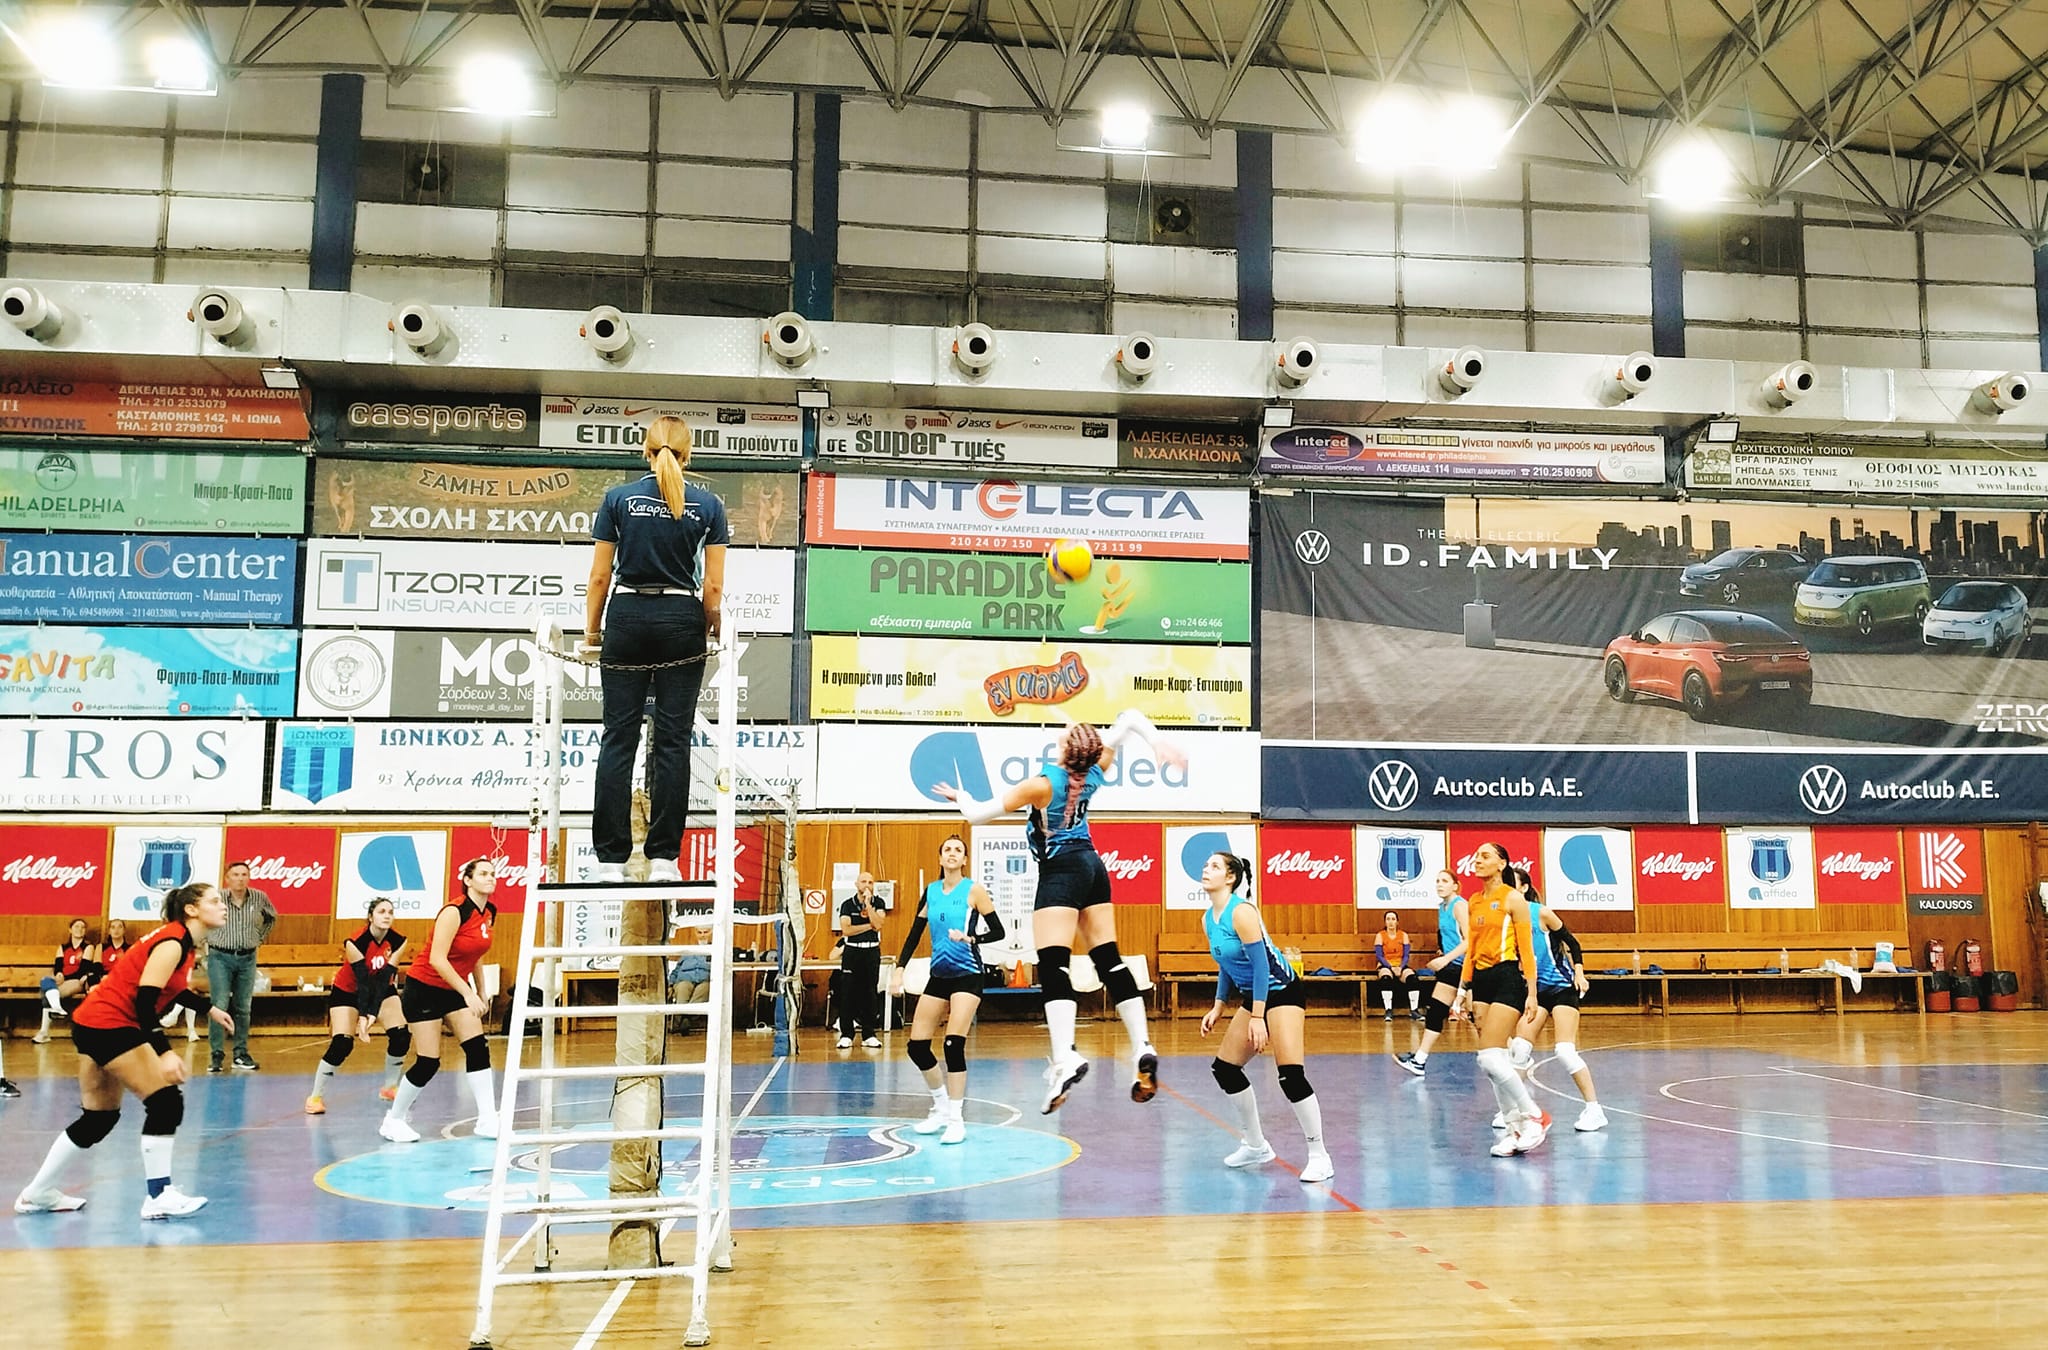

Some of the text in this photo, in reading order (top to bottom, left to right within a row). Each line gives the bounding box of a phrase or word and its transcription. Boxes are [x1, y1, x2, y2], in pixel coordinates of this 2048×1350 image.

[0, 381, 74, 396] ΩΛΕΙΟ
[118, 385, 187, 396] ΔΕΚΕΛΕΙΑΣ
[153, 398, 174, 408] 210
[177, 399, 227, 409] 2533079
[546, 404, 573, 414] PUMA
[594, 405, 619, 415] asics
[116, 410, 201, 421] ΚΑΣΤΑΜΟΝΗΣ
[204, 413, 228, 424] 142,
[248, 414, 281, 424] ΙΩΝΙΑ
[349, 402, 527, 436] cassports
[922, 418, 947, 427] PUMA
[969, 418, 991, 428] asics
[151, 422, 172, 432] 210
[175, 423, 224, 433] 2799701
[856, 430, 947, 456] super
[1228, 434, 1249, 448] 53,
[1295, 436, 1349, 447] intered
[1593, 443, 1607, 451] και
[1735, 445, 1854, 455] ΑΡΧΙΤΕΚΤΟΝΙΚΗ ΤΟΠΙΟΥ
[1764, 457, 1814, 465] ΠΡΑΣΙΝΟΥ
[1386, 464, 1431, 473] ΔΕΚΕΛΕΙΑΣ
[1434, 465, 1449, 474] 114
[1735, 467, 1838, 477] ΓΗΠΕΔΑ ΤΕΝΝΙΣ
[418, 468, 571, 497] ΣΑΜΗΣ LAND
[1735, 478, 1811, 487] ΑΠΟΛΥΜΑΝΣΕΙΣ
[1874, 479, 1893, 488] 210
[369, 505, 476, 530] ΣΧΟΛΗ
[486, 508, 599, 534] ΣΚΥΛΩ
[884, 520, 934, 530] ΣΥΣΤΗΜΑΤΑ
[936, 522, 992, 532] ΣΥΝΑΓΕΡΜΟΥ
[1001, 525, 1040, 534] ΚΑΜΕΡΕΣ
[1042, 527, 1090, 536] ΑΣΦΑΛΕΙΑΣ
[1418, 528, 1445, 540] THE
[950, 536, 1032, 549] 210 24 07 150
[1112, 543, 1124, 552] 11
[1129, 544, 1143, 553] 99
[1362, 541, 1620, 571] ID.FAMILY
[68, 587, 115, 602] Αθλητική
[118, 588, 193, 604] Αποκατάσταση
[203, 589, 240, 601] Manual
[243, 590, 283, 605] Therapy
[745, 593, 780, 605] ΖΩΗΣ
[387, 598, 515, 614] INSURANCE
[727, 608, 772, 618] ΥΓΕΙΑΣ
[982, 601, 1065, 632] PARK
[439, 686, 495, 703] Σάρδεων
[291, 730, 347, 740] ΙΩΝΙΚΟΣ
[380, 728, 484, 747] ΙΩΝΙΚΟΣ
[378, 770, 462, 792] 93 Χρόνια
[1433, 777, 1534, 797] Autoclub
[1540, 777, 1583, 797] A.E.
[1860, 780, 1954, 799] Autoclub
[1960, 782, 2000, 799] A.E.
[24, 794, 81, 805] GREEK
[2, 855, 98, 888] Kellogg's
[1267, 851, 1345, 879] Kellogg's
[1642, 853, 1717, 881] Kellogg's
[1821, 852, 1894, 880] Kellogg's
[1392, 887, 1428, 898] affidea
[1566, 889, 1615, 902] affidea
[1763, 887, 1797, 898] affidea
[1919, 900, 1973, 910] KALOUSOS
[480, 923, 488, 938] 2
[371, 955, 385, 969] 10
